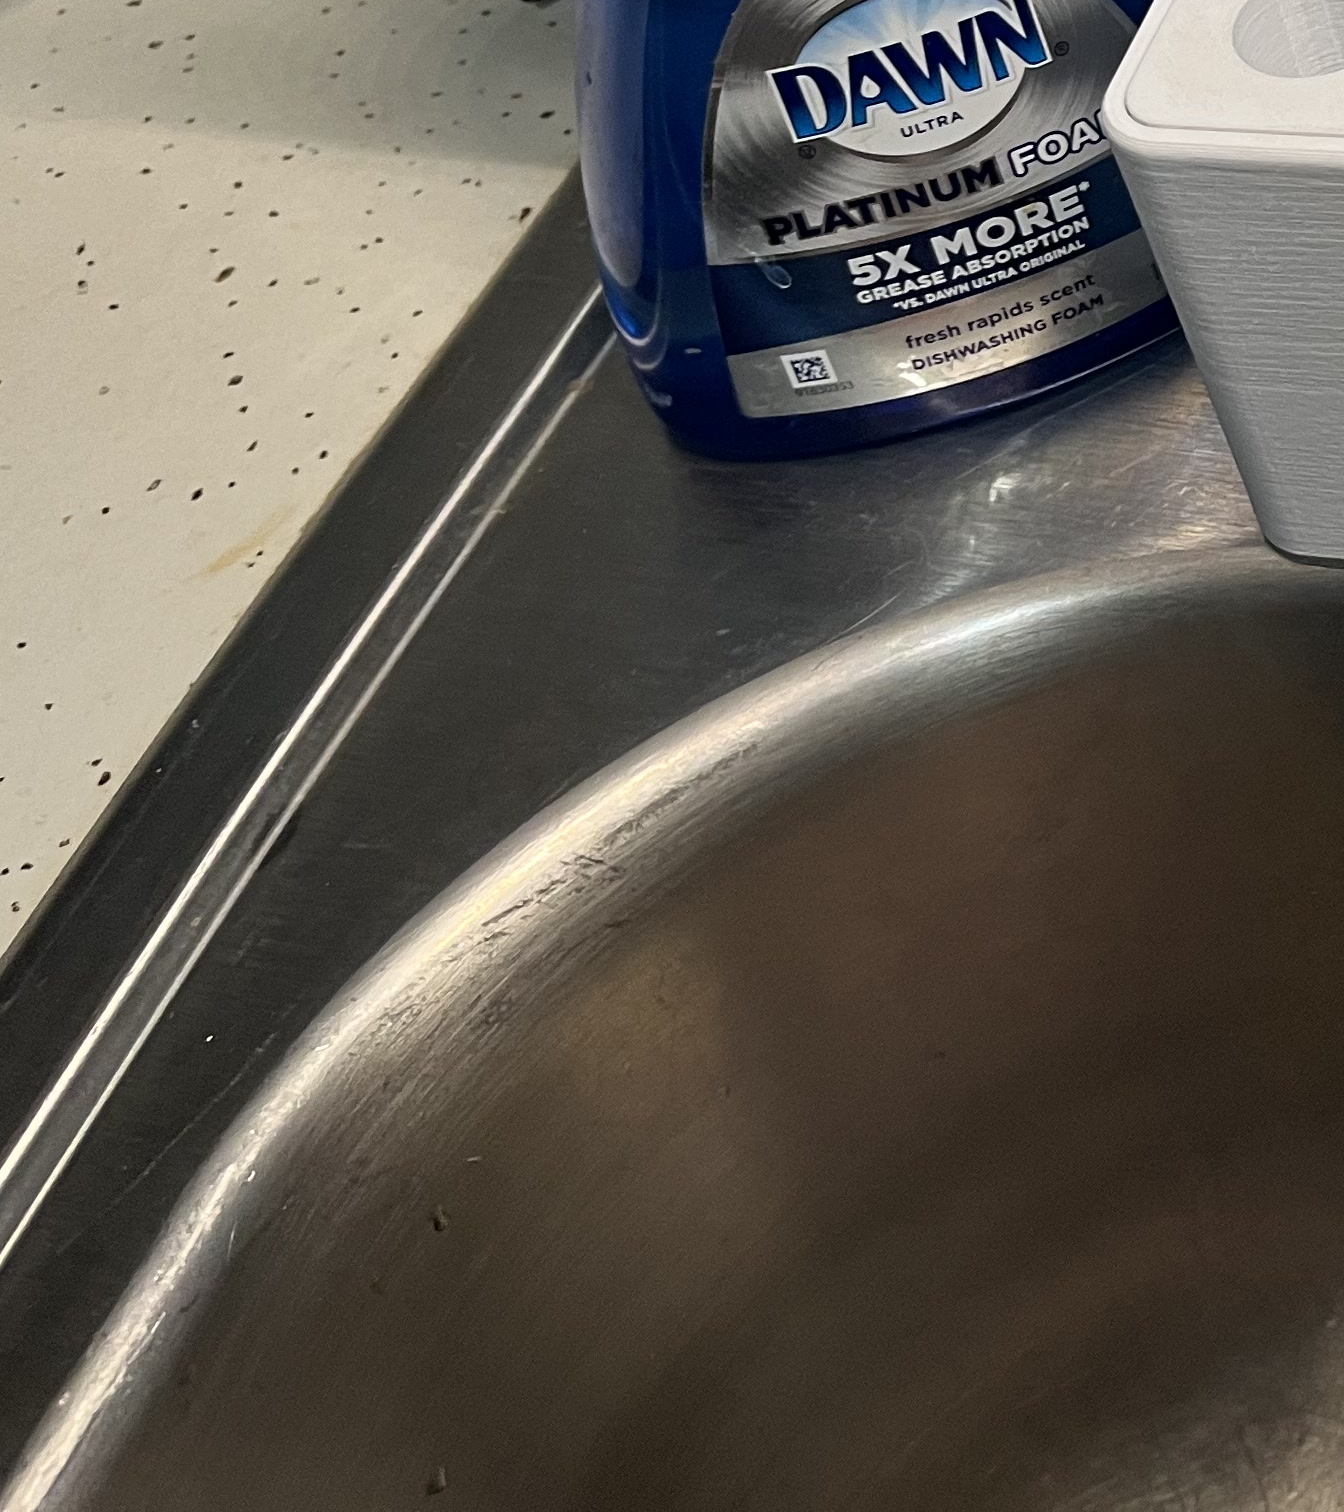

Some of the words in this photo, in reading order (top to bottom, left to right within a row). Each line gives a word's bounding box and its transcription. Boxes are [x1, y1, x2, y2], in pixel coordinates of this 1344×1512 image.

[900, 110, 964, 138] ULTRA
[763, 157, 1004, 246] PLATINUM
[1008, 108, 1107, 179] FOA
[847, 244, 922, 286] 5X
[856, 270, 947, 304] GREASE
[951, 216, 1090, 281] ABSORPTION
[925, 282, 970, 304] DAWN
[972, 269, 1018, 289] ULTRA
[1019, 239, 1087, 272] ORIGINAL
[904, 324, 961, 350] fresh
[967, 299, 1034, 331] rapids
[1039, 273, 1096, 307] scent
[912, 318, 1048, 371] DISHWASHING
[1052, 293, 1105, 326] FOAM
